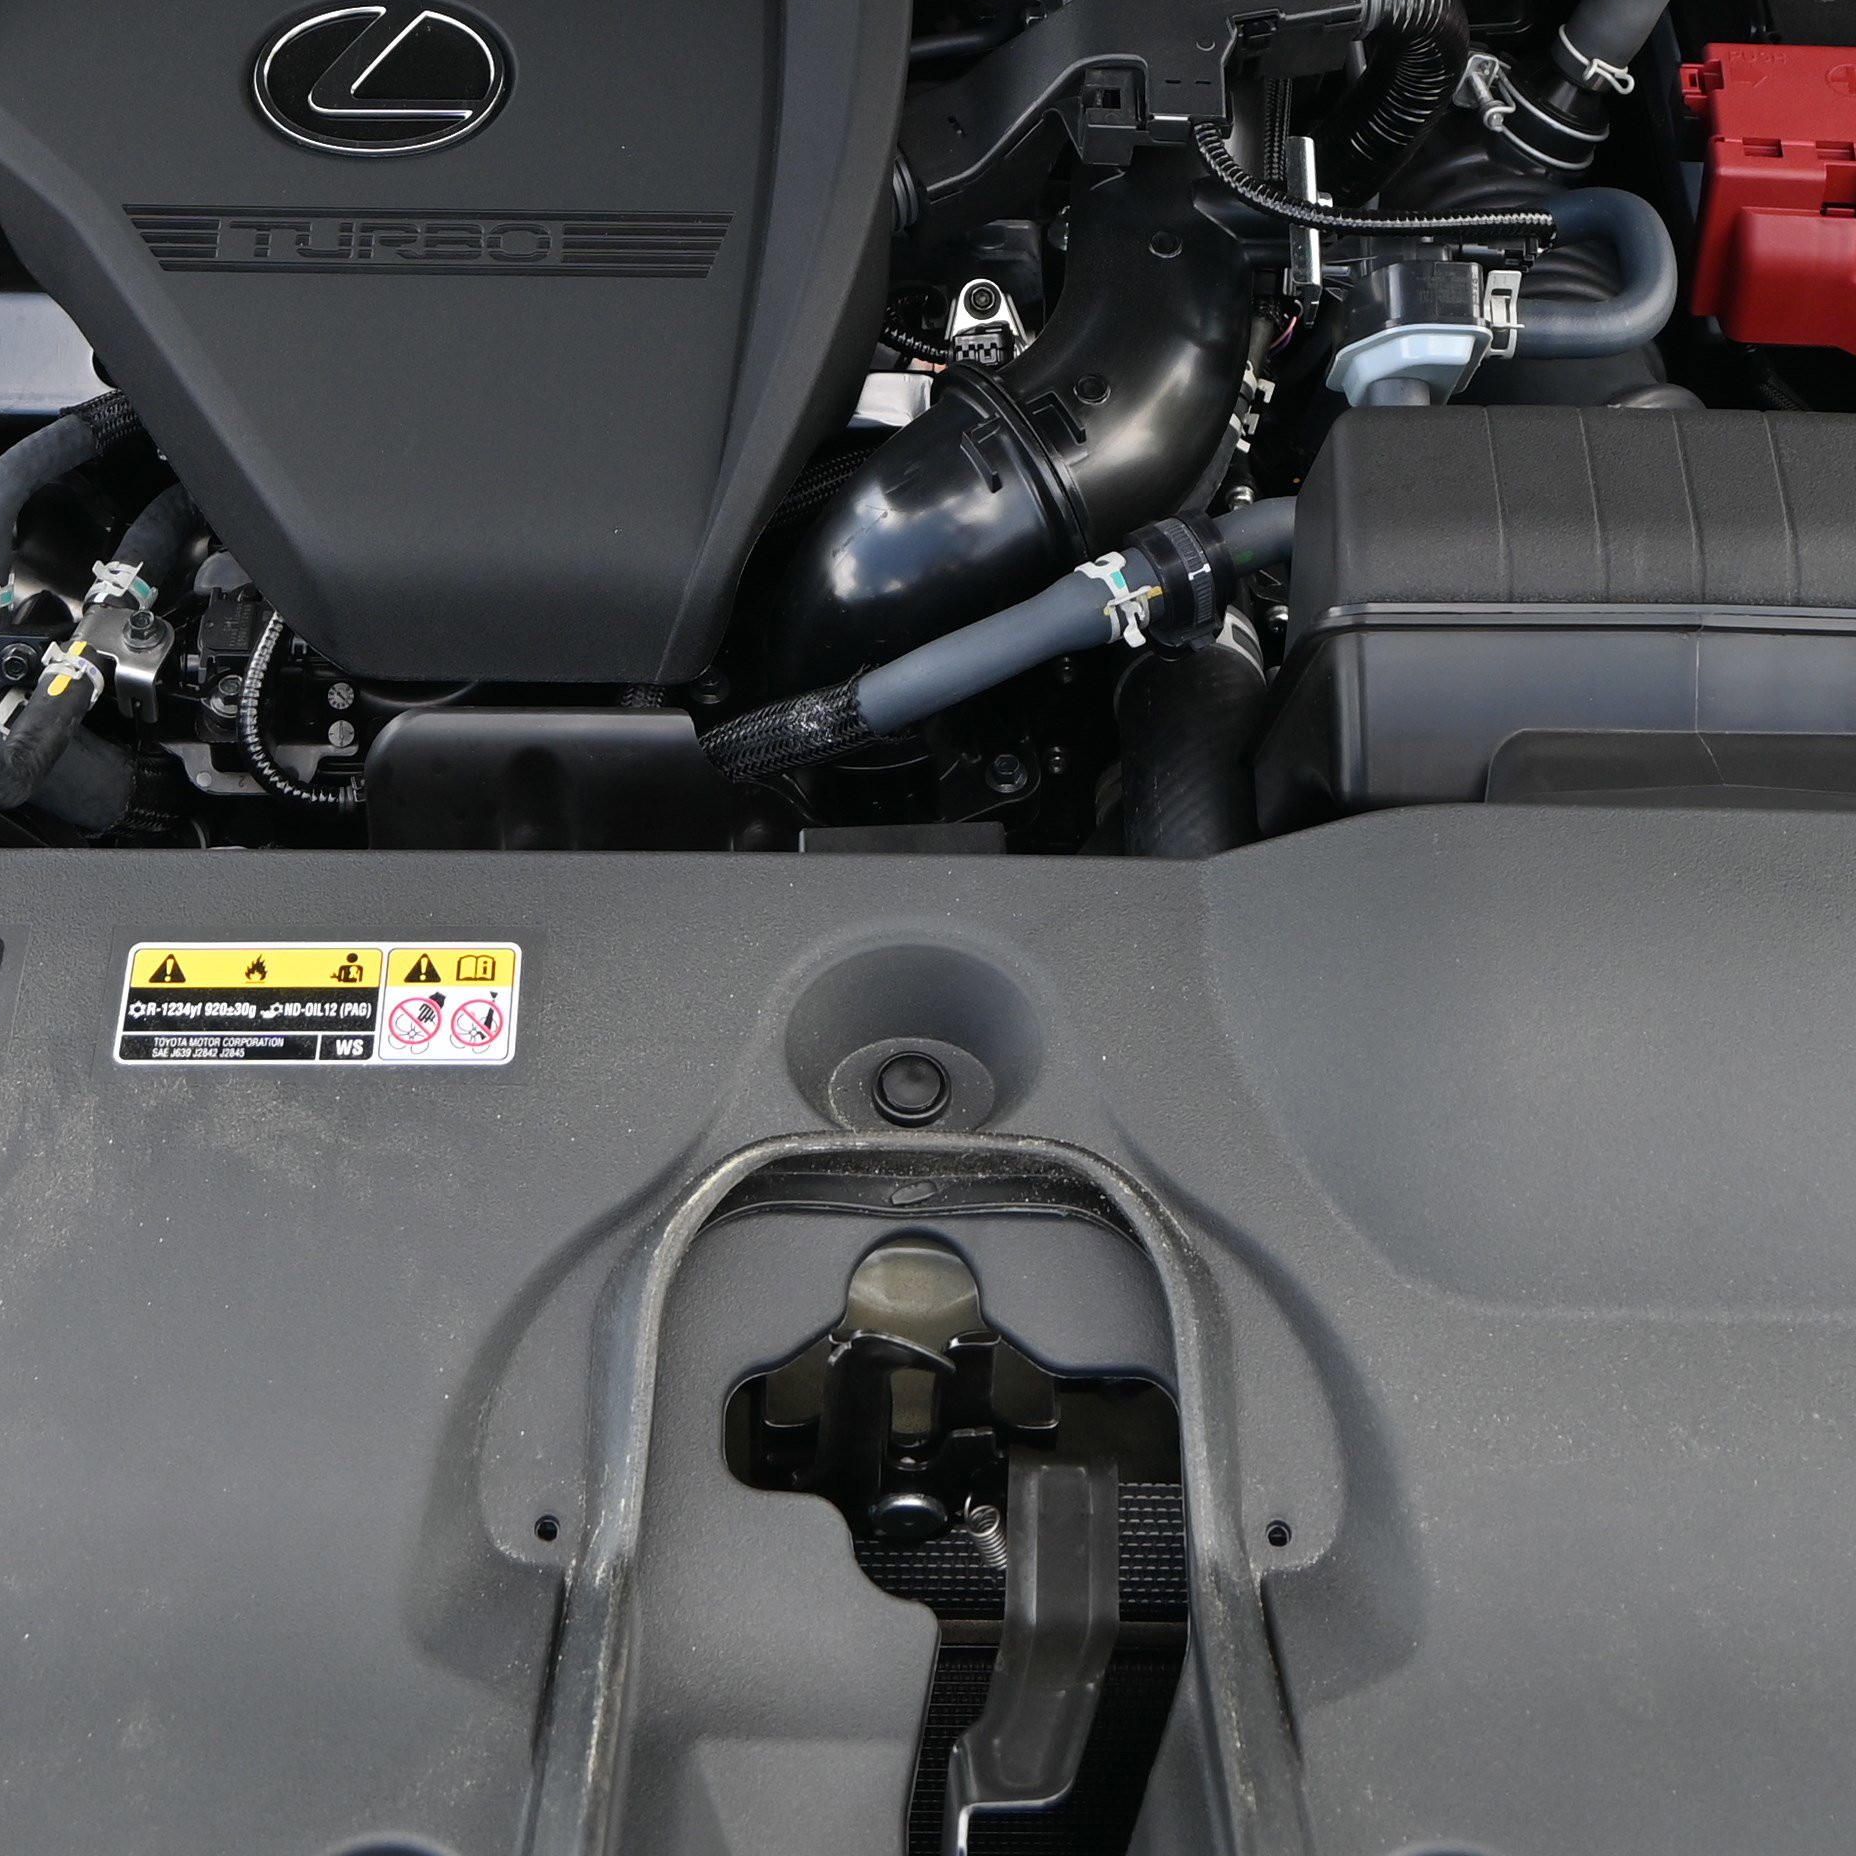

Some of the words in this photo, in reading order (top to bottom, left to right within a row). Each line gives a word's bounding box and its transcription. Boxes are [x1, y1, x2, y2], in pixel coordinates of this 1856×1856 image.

[231, 219, 554, 263] TURBO
[146, 1002, 202, 1019] R-1234yf
[205, 1002, 257, 1019] 920±30g
[339, 1003, 372, 1020] (PAG)
[153, 1037, 187, 1048] TOYOTA
[188, 1037, 220, 1048] MOTOR
[222, 1037, 284, 1048] CORPORATION
[335, 1039, 364, 1056] WS
[152, 1048, 168, 1058] SAE
[169, 1048, 190, 1058] J639
